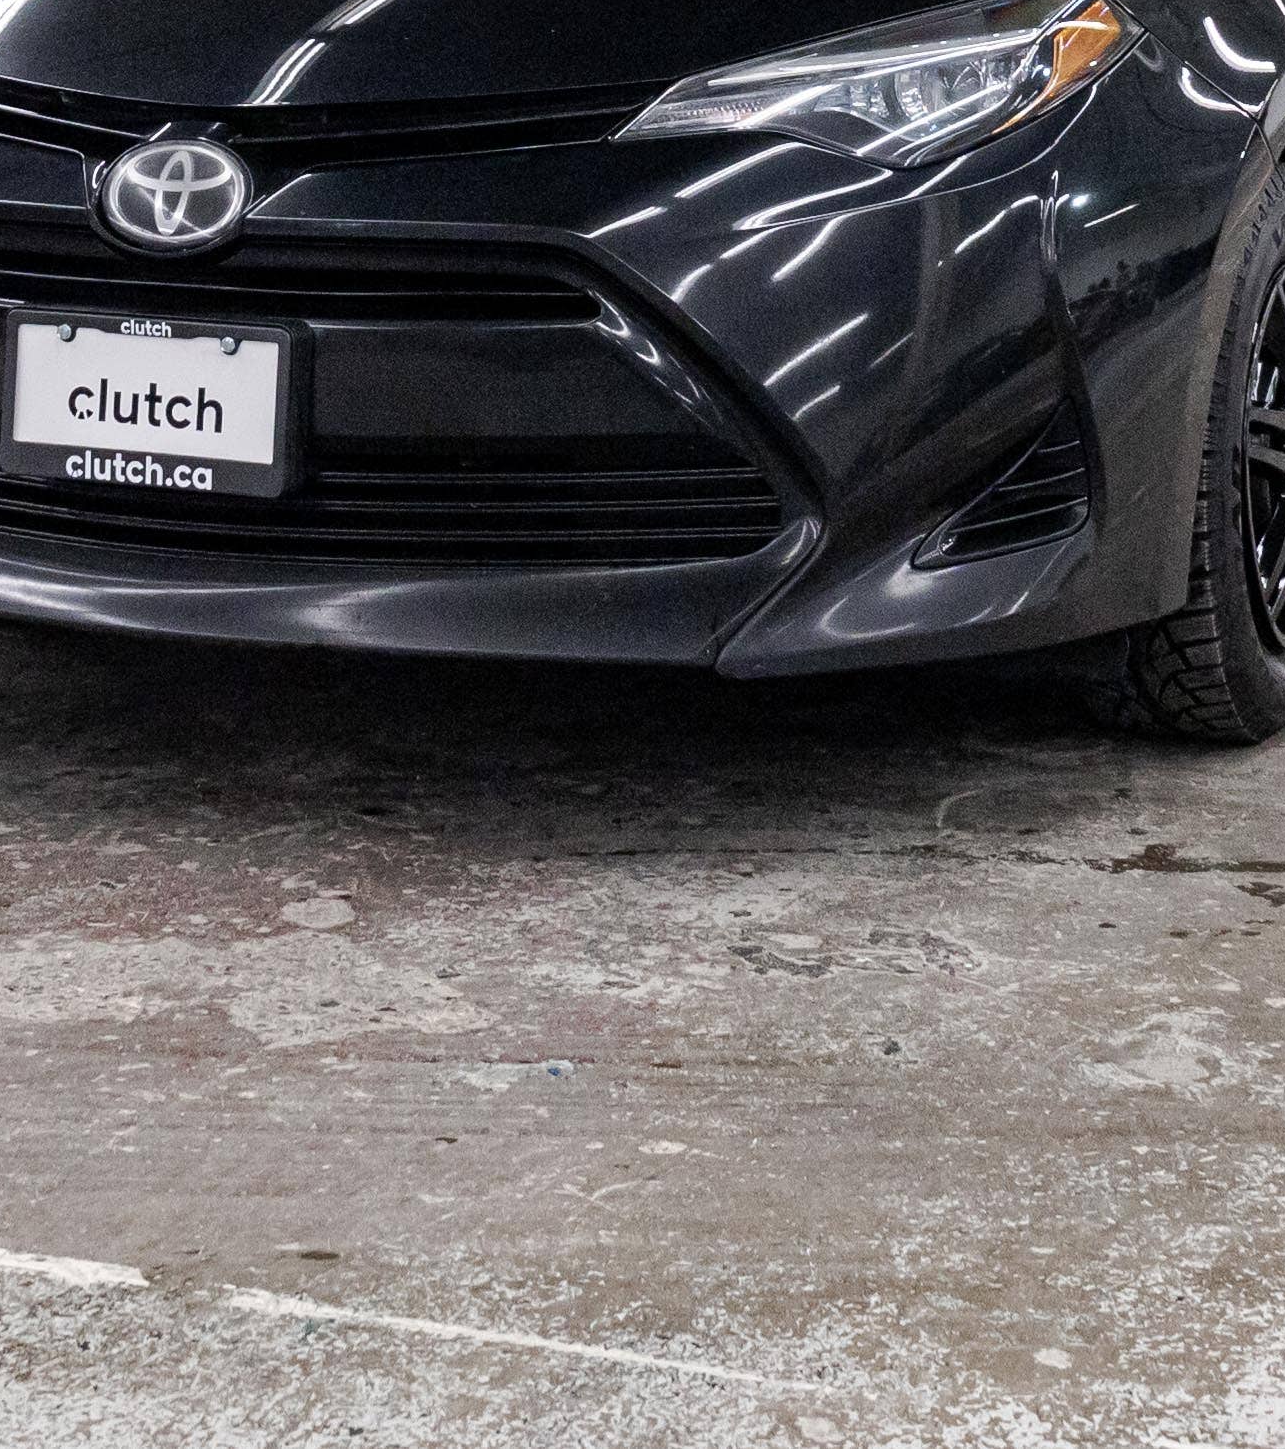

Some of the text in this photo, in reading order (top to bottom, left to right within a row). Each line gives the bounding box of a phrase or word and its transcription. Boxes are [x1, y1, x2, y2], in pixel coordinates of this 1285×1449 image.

[120, 319, 172, 338] clutch
[67, 378, 223, 433] clutch
[66, 450, 213, 491] clutch.ca
